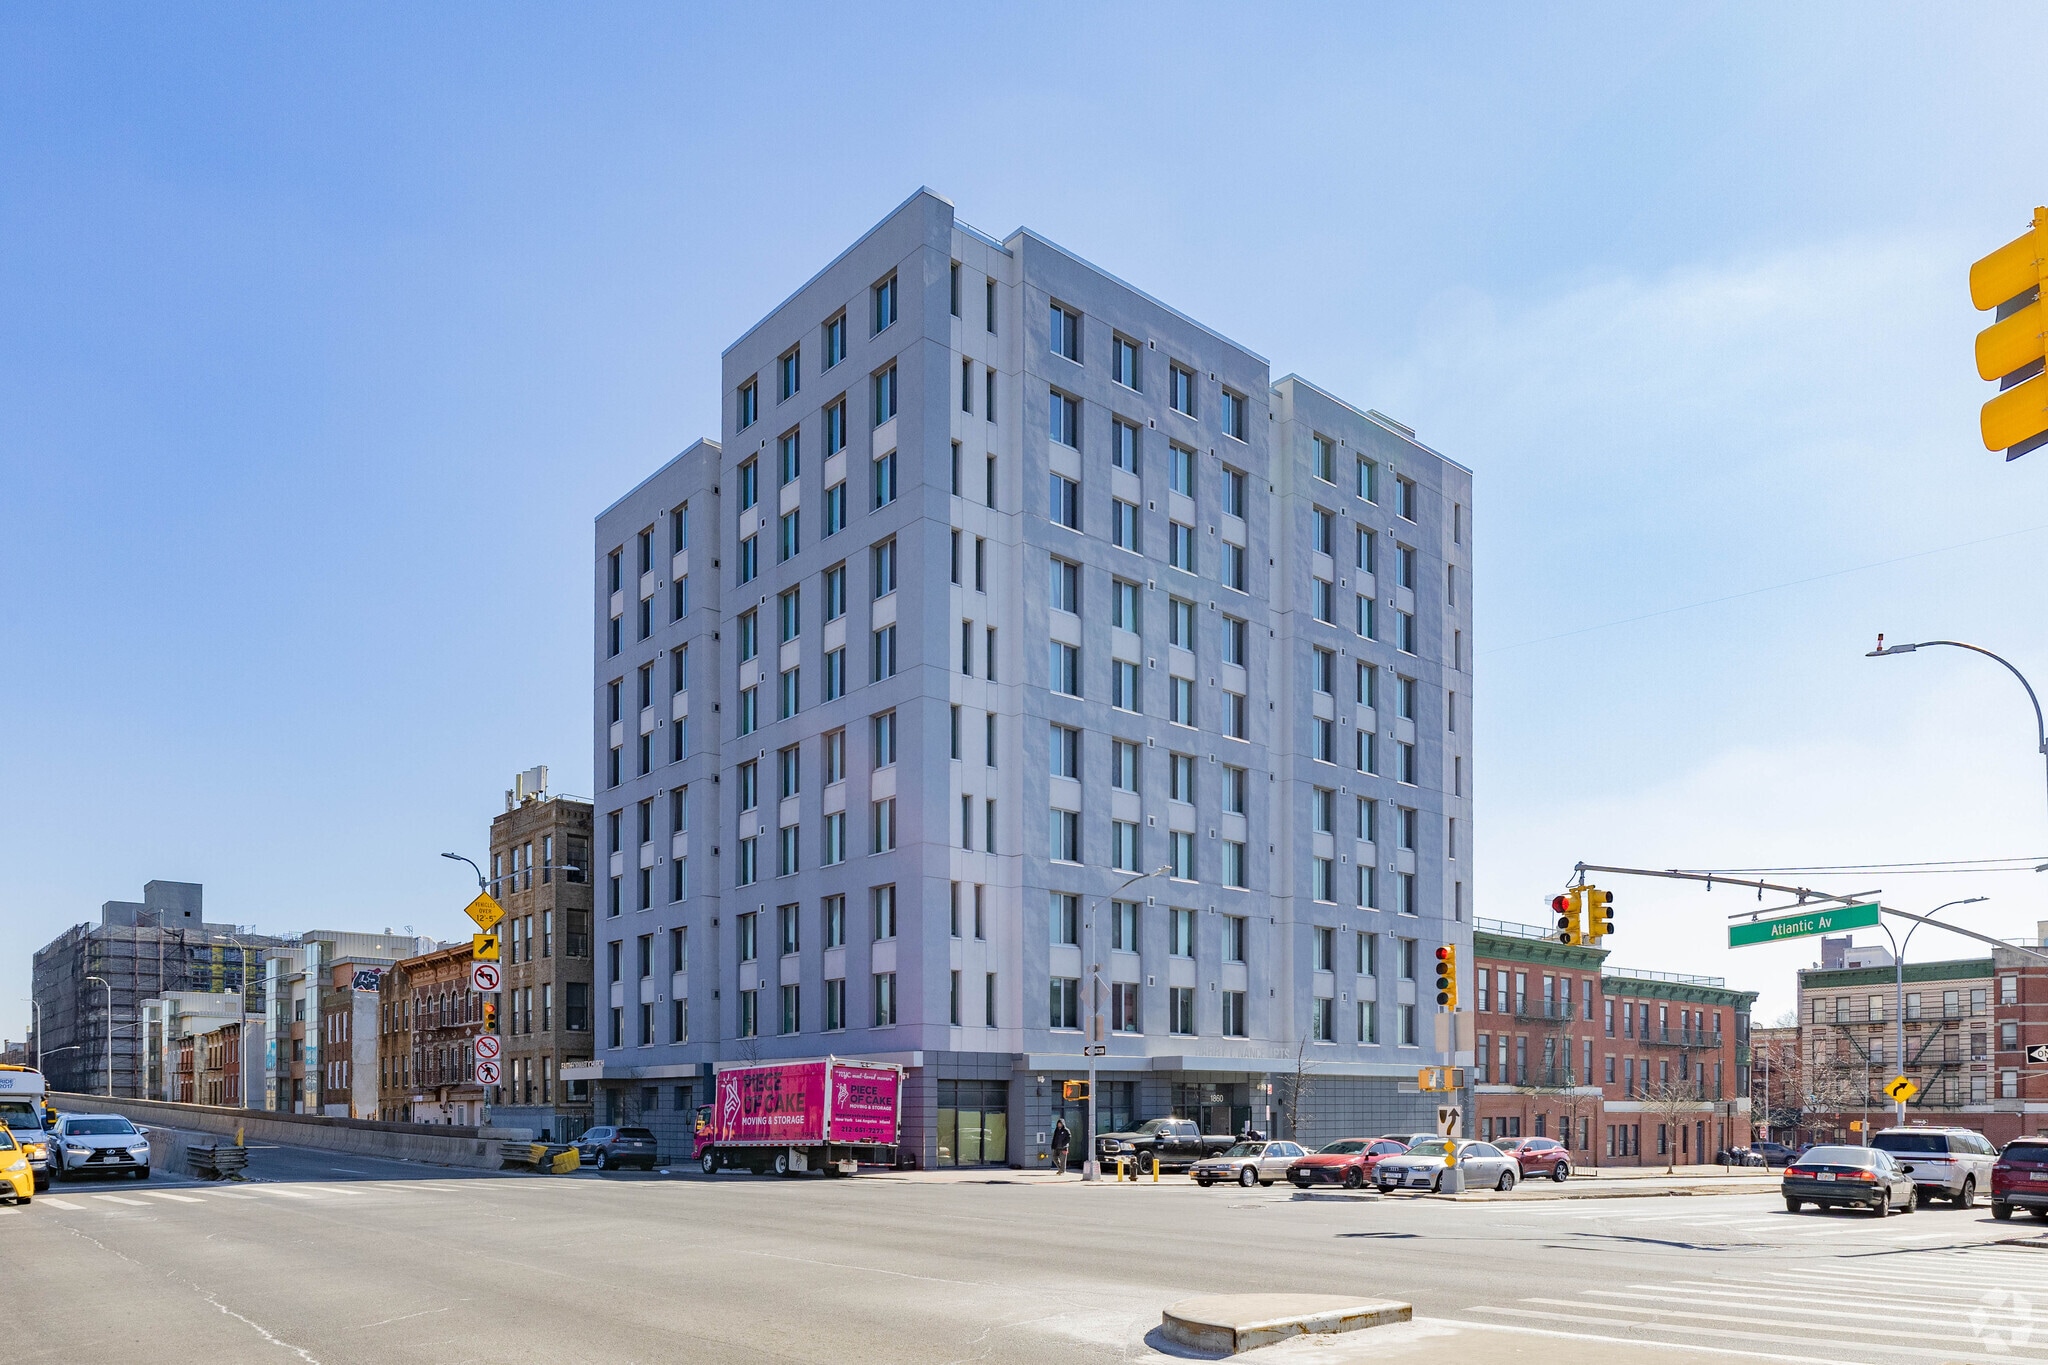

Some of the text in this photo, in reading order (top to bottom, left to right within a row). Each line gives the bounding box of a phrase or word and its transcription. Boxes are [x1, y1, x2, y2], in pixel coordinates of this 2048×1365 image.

[1771, 916, 1832, 936] Atlantic Av
[743, 1071, 782, 1093] PIECE
[850, 1085, 878, 1095] PIECE
[744, 1092, 805, 1114] OF CAKE
[850, 1094, 893, 1106] OF CAKE
[1210, 1094, 1224, 1103] 1860
[742, 1115, 805, 1126] MOVING & STORAGE
